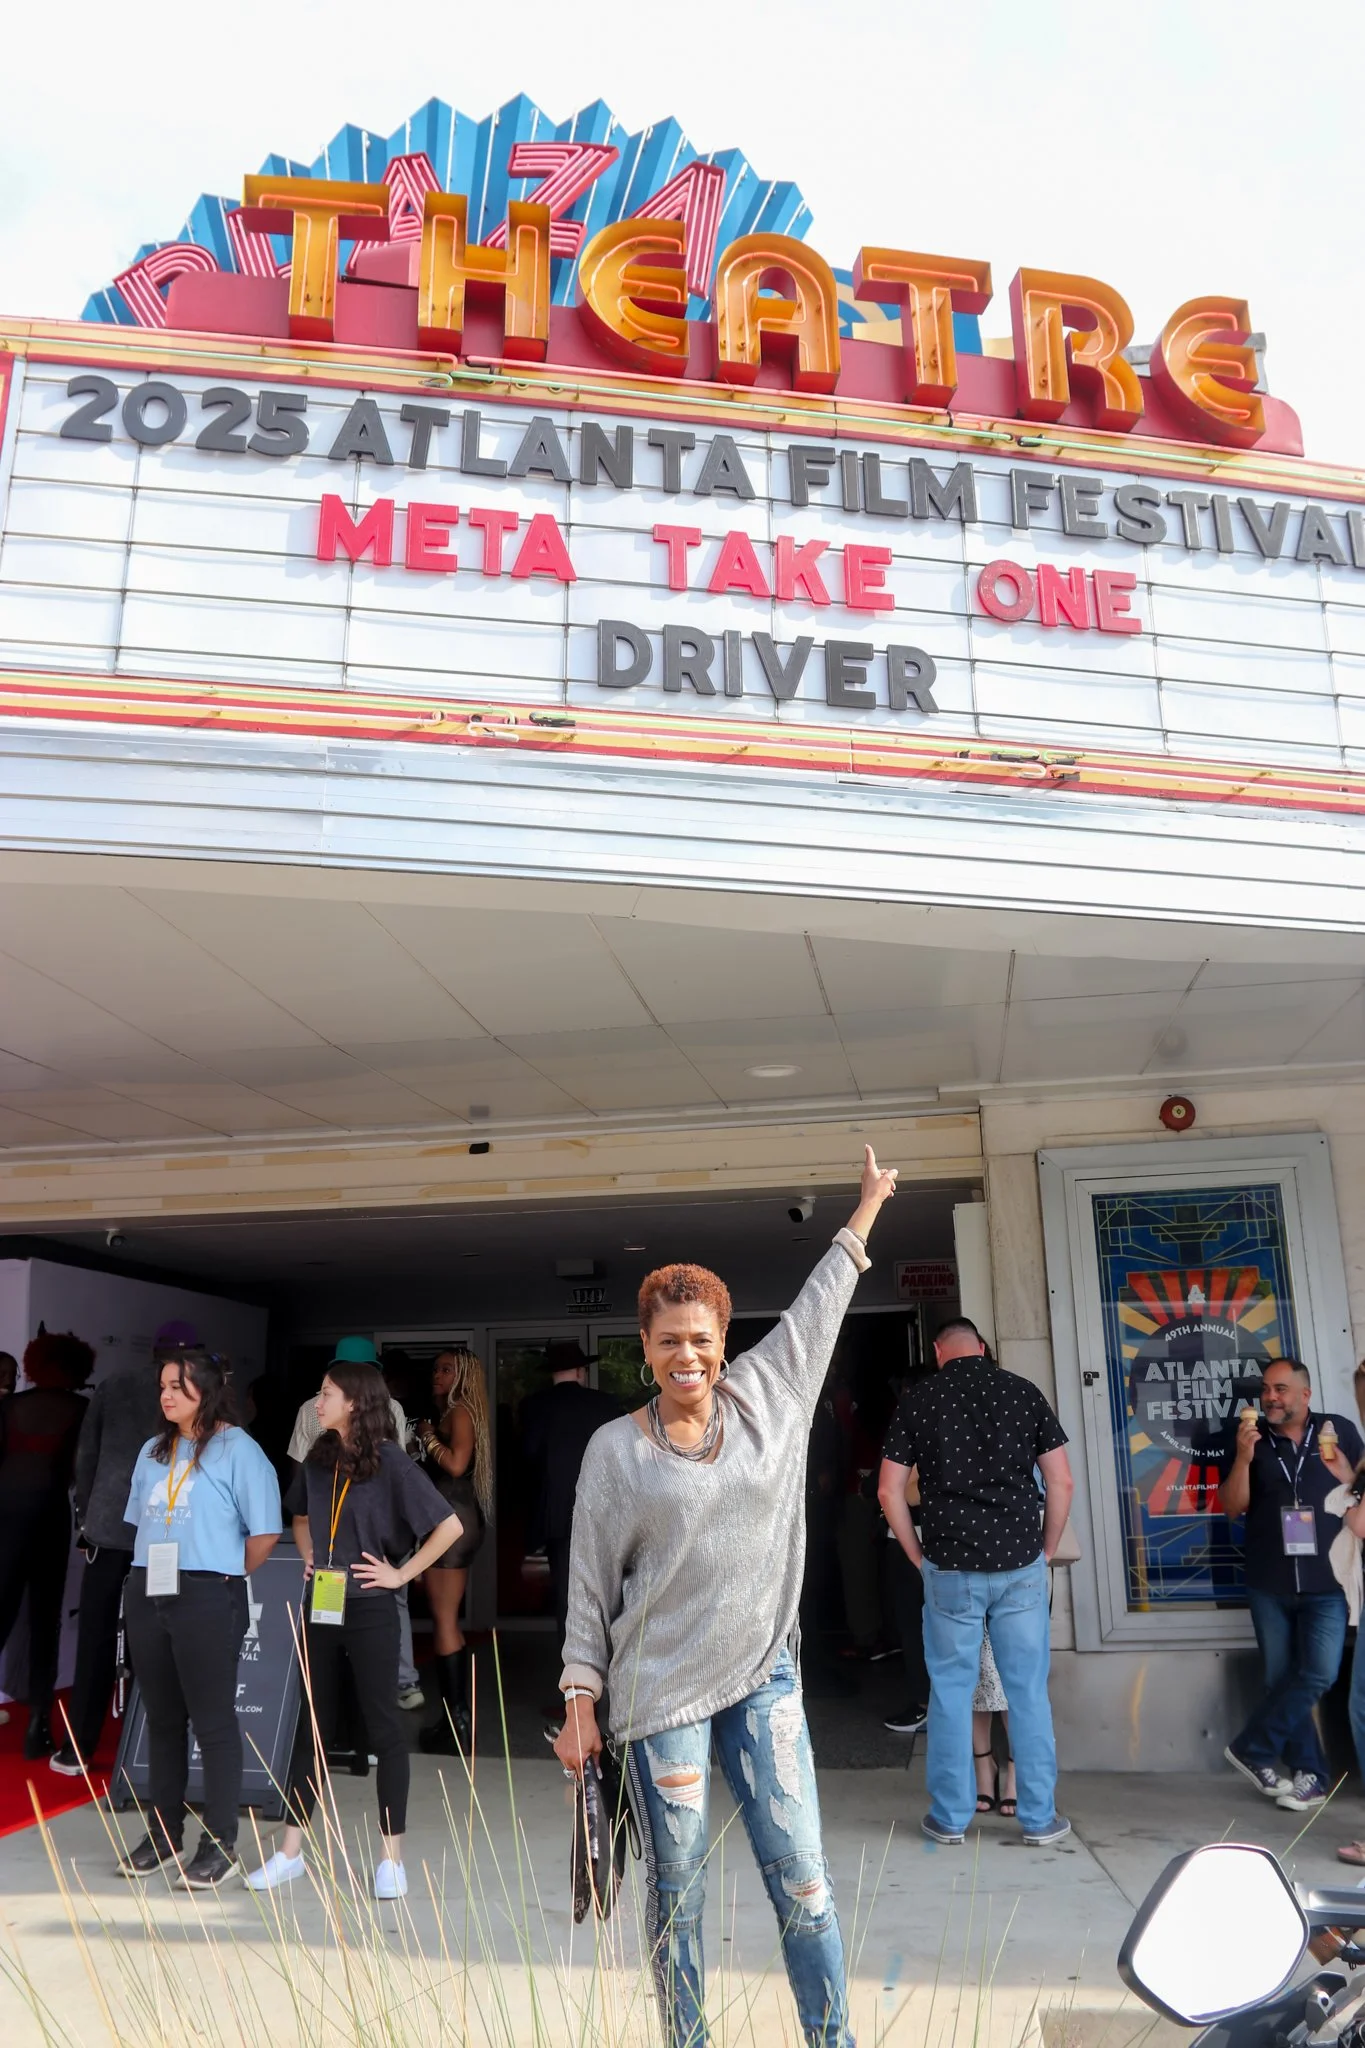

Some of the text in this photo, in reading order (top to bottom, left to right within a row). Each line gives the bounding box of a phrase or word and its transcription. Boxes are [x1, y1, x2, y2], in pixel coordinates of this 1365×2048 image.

[240, 173, 1266, 450] THEATRE
[60, 374, 309, 457] 2025
[327, 397, 756, 500] ATLANTA
[788, 444, 979, 524] FILM
[316, 493, 1143, 636] META TAKE ONE
[597, 618, 939, 714] DRIVER
[901, 1272, 955, 1288] PARKING
[1164, 1323, 1238, 1342] 49TH ANNUAL
[1144, 1358, 1264, 1382] ATLANTA
[1176, 1379, 1234, 1400] FILM
[1146, 1397, 1266, 1421] FESTIVAL
[1160, 1430, 1180, 1449] APRIL
[1180, 1445, 1201, 1457] 24TH
[1207, 1448, 1226, 1458] MAY
